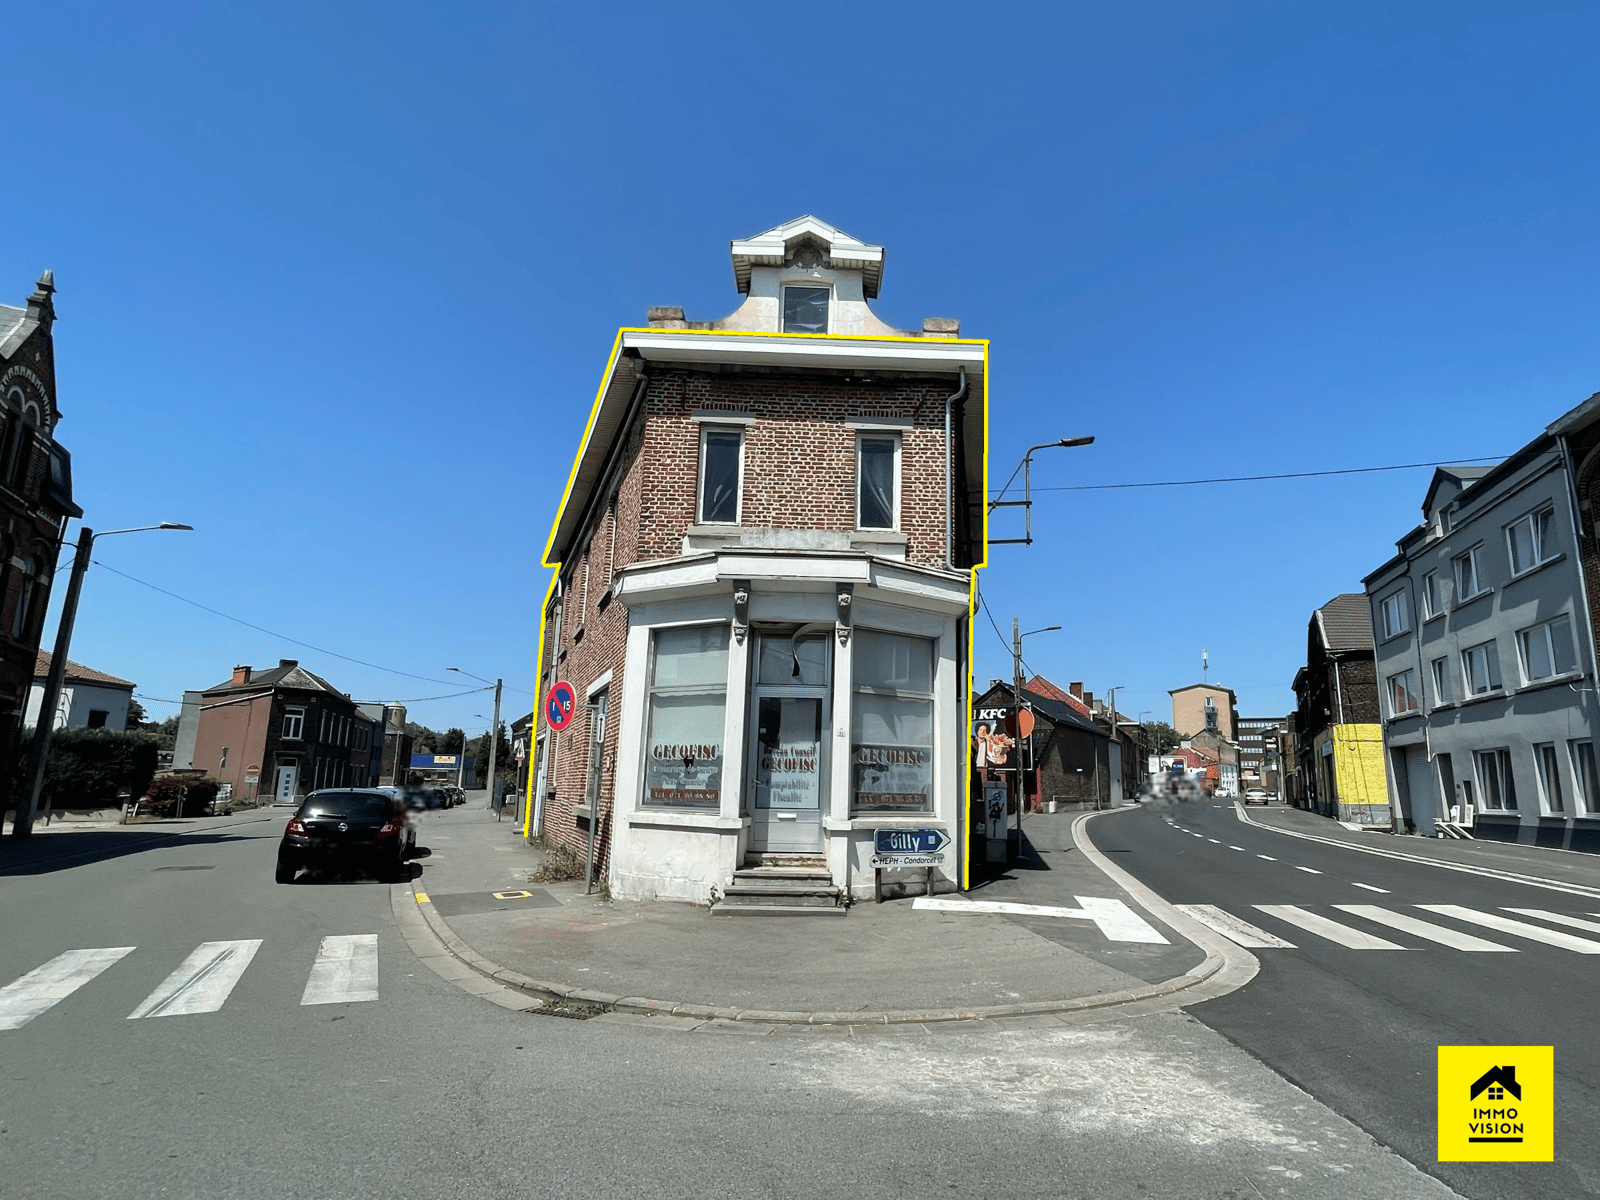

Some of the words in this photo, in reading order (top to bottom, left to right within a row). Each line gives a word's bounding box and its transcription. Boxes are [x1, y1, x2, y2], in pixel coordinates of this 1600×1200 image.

[978, 708, 1007, 720] KFC
[652, 743, 720, 761] GECOFISC
[855, 747, 925, 767] GECOFISC
[761, 756, 818, 773] GECOFISC
[890, 832, 921, 853] Gilly
[879, 857, 899, 865] HEPH
[903, 856, 937, 864] Condorcet
